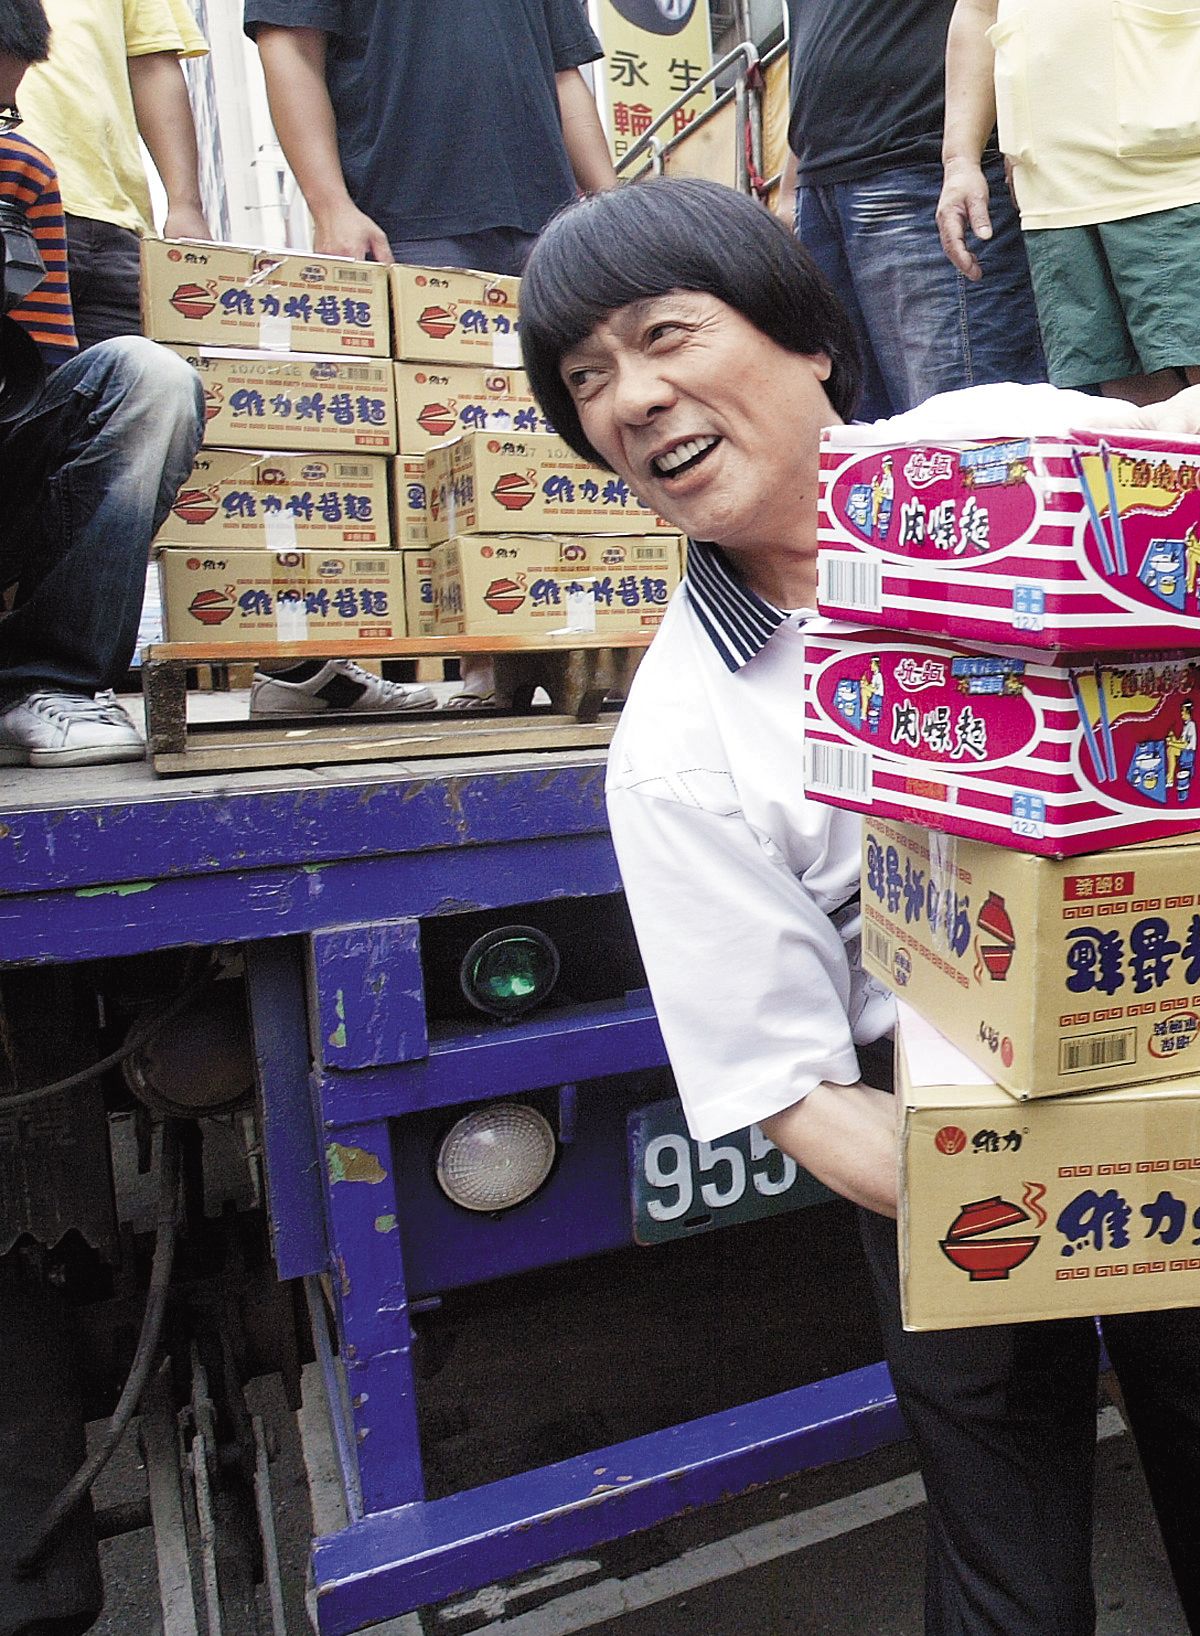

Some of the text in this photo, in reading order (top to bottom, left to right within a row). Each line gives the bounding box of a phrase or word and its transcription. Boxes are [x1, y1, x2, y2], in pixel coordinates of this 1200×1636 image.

[609, 50, 706, 94] 永生
[219, 288, 373, 327] 維力炸醬麵
[459, 309, 521, 335] 維力
[229, 388, 388, 426] 維力炸醬麵
[222, 491, 374, 522] 維力炸醬麵
[542, 475, 650, 508] 維力炸
[891, 699, 988, 760] 肉燥麵
[971, 1127, 1023, 1155] 維力
